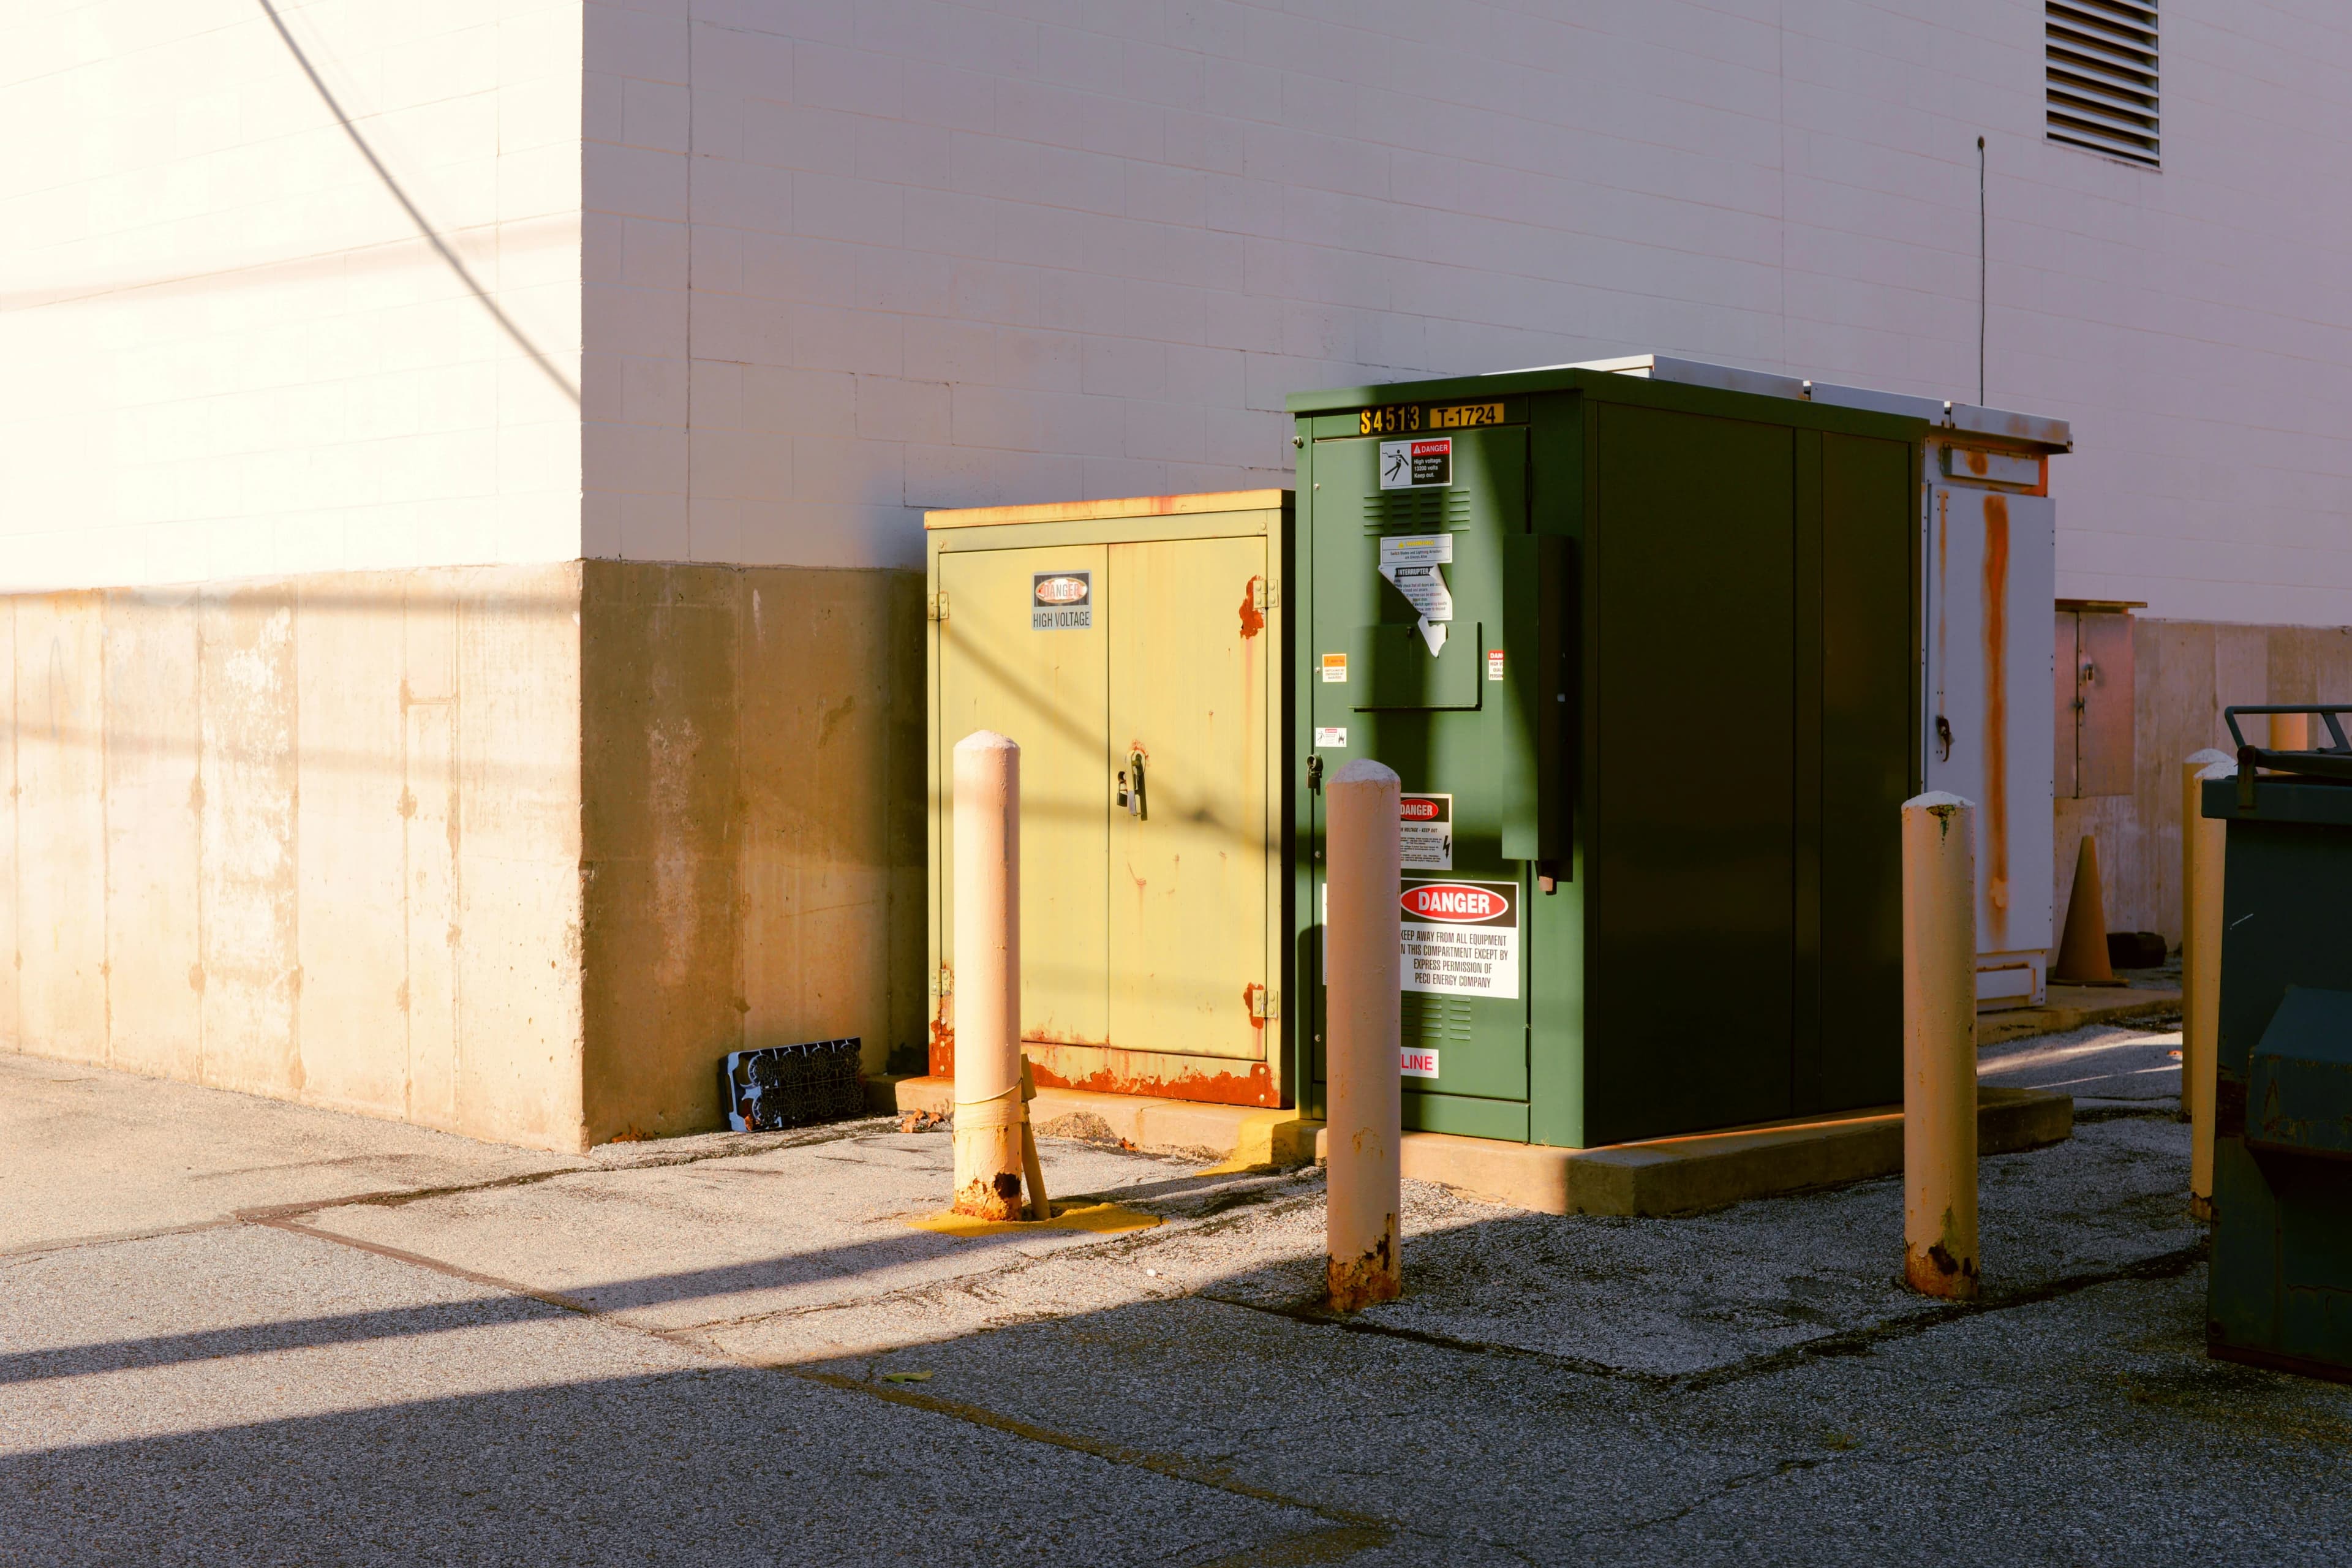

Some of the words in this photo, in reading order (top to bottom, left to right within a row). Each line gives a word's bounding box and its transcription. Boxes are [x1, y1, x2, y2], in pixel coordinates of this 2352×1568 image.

[1360, 405, 1419, 434] S4513
[1438, 406, 1496, 427] T-1724
[1422, 444, 1448, 453] DANGER
[1044, 584, 1079, 597] DANGER
[1033, 612, 1052, 627] HIGH
[1055, 611, 1090, 627] VOLTAGE
[1401, 804, 1433, 816] DANGER
[1418, 891, 1490, 914] DANGER
[1416, 930, 1434, 941] AWAY
[1436, 932, 1454, 943] FROM
[1457, 933, 1467, 944] ALL
[1469, 933, 1507, 946] EQUIPMENT
[1401, 944, 1405, 954] N
[1408, 944, 1422, 955] THIS
[1423, 945, 1472, 959] COMPARTMENT
[1474, 948, 1498, 960] EXCEPT
[1500, 950, 1508, 961] BY
[1414, 959, 1441, 971] EXPRESS
[1442, 960, 1482, 973] PERMISSION
[1484, 963, 1492, 974] OF
[1415, 973, 1431, 984] PECO
[1433, 974, 1457, 986] ENERGY
[1459, 975, 1491, 988] COMPANY
[1401, 1054, 1433, 1071] LINE
